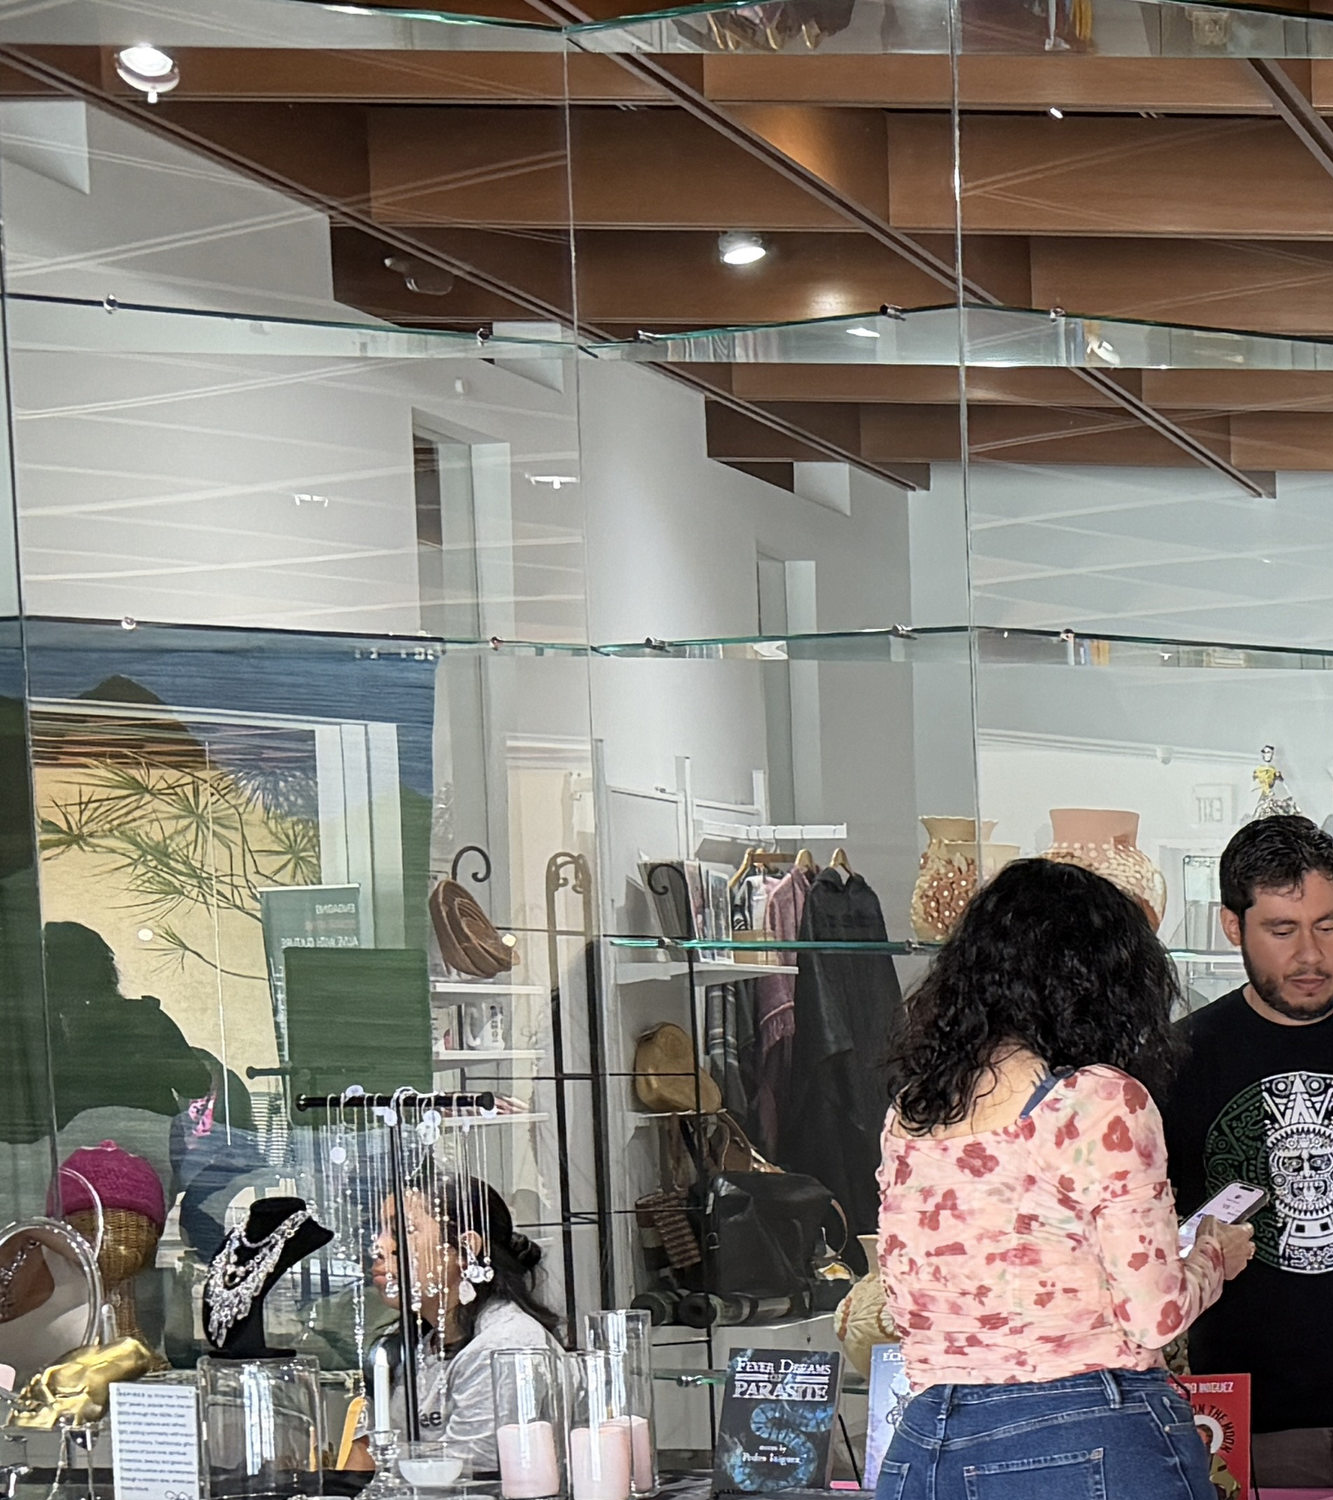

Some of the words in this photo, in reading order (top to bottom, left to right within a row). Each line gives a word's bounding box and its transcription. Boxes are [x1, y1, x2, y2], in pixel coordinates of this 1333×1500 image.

[735, 1357, 775, 1374] FEVER
[732, 1381, 829, 1401] PARASITE
[1208, 1404, 1228, 1421] THE
